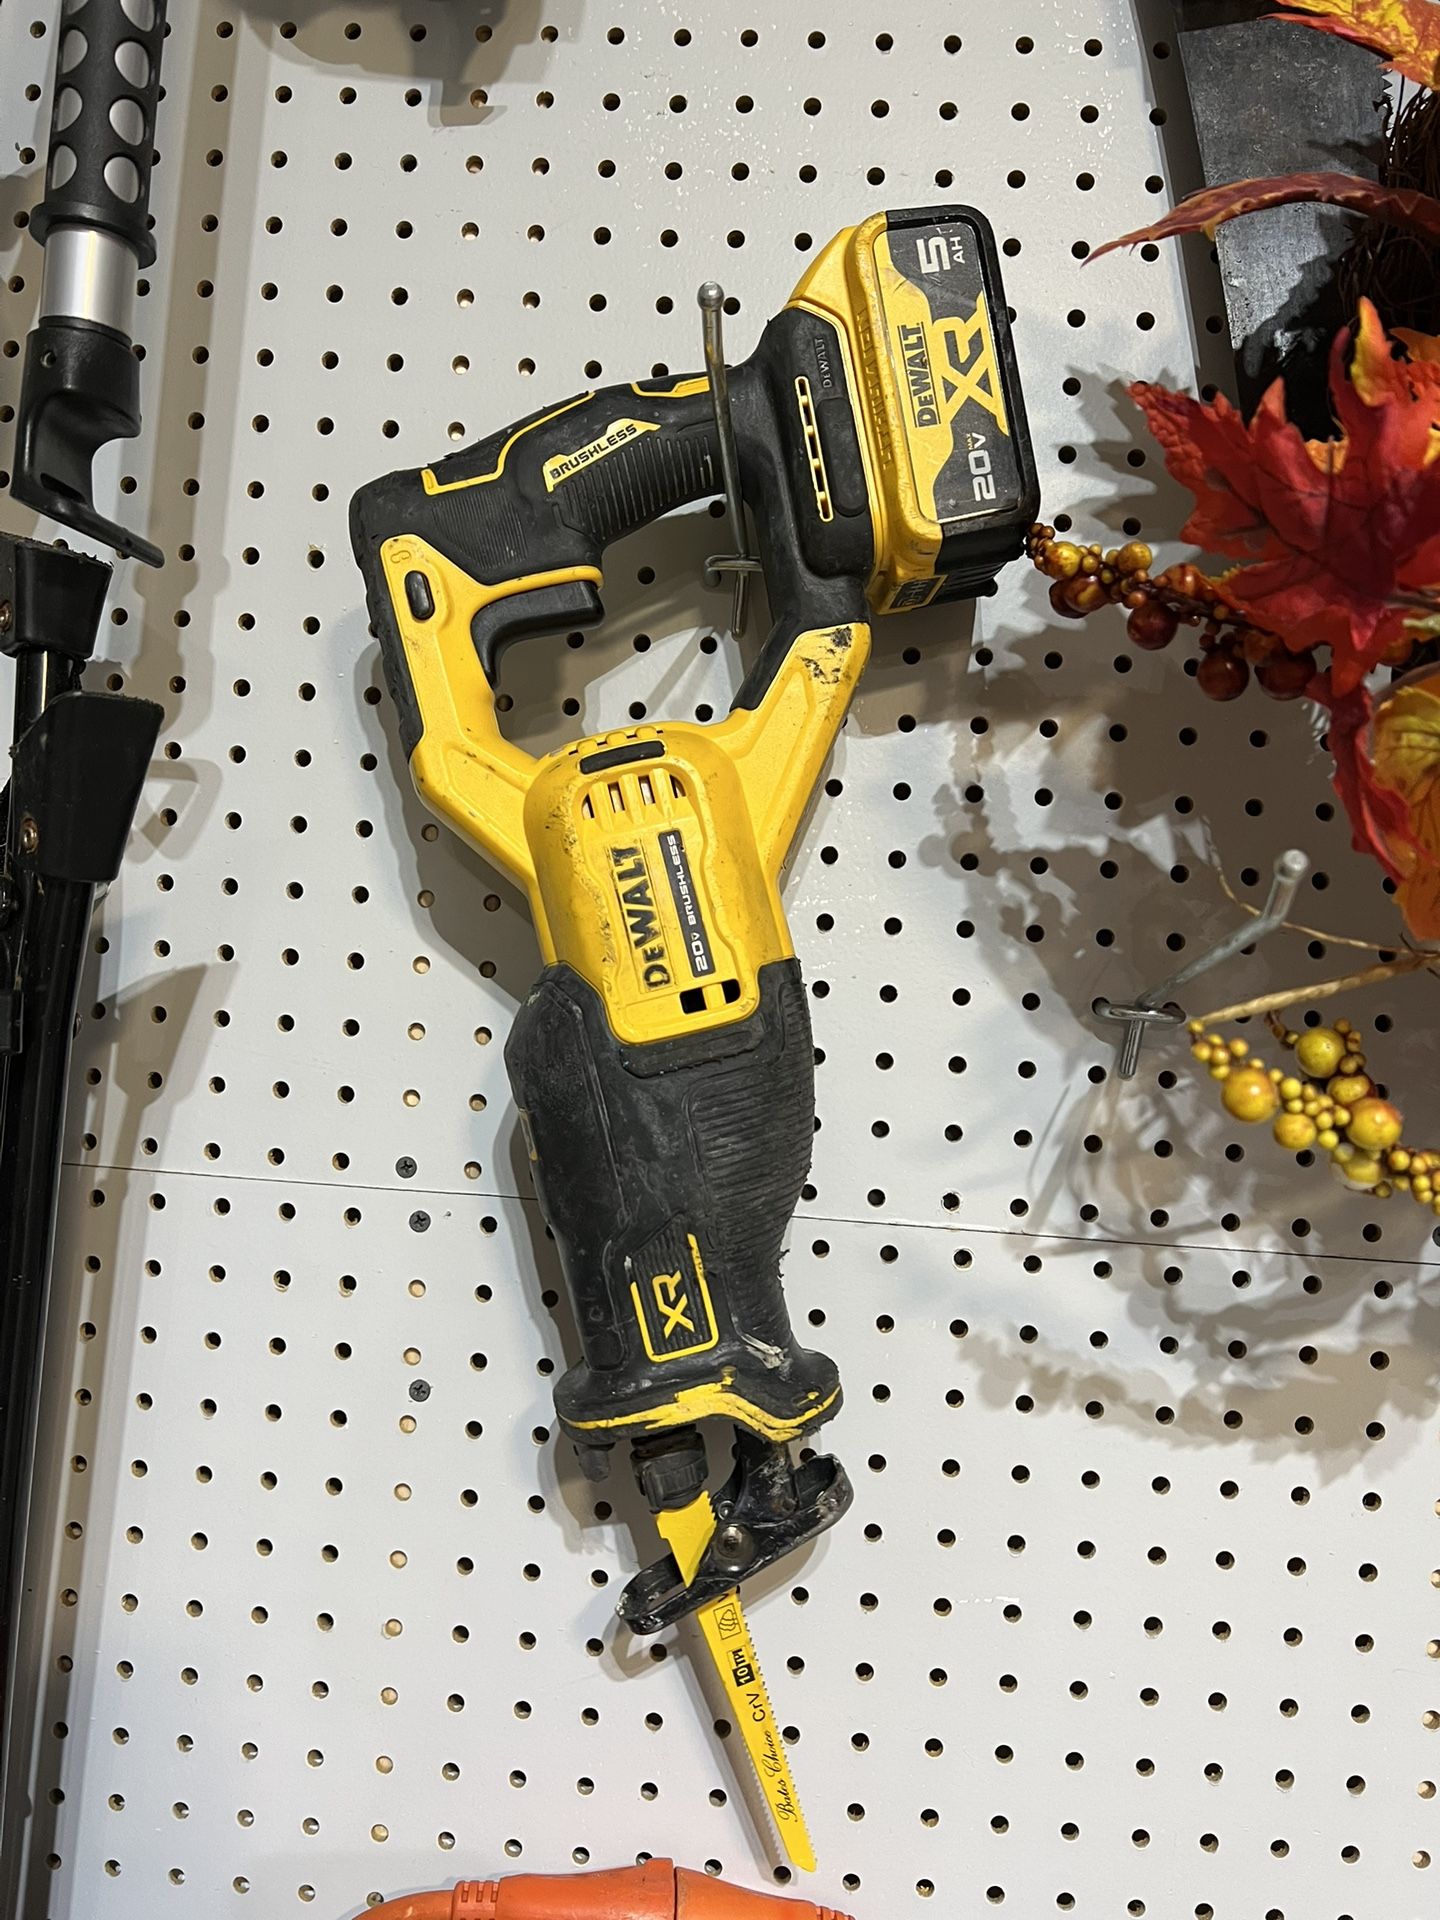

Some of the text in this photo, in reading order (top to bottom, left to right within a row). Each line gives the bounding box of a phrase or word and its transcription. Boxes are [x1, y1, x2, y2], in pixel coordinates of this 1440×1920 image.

[916, 236, 951, 274] 5
[951, 236, 966, 264] AH
[814, 336, 833, 389] DEWALT
[901, 323, 939, 427] DEWALT
[934, 296, 1009, 437] XR
[549, 423, 638, 480] BRUSHLESS
[968, 432, 996, 501] 20V
[666, 834, 697, 926] BRUSHLESS
[610, 846, 671, 988] DEWALT
[652, 1269, 694, 1339] XR
[732, 1648, 751, 1684] 10 TPI
[746, 1693, 766, 1722] CrV
[762, 1730, 783, 1777] Choice
